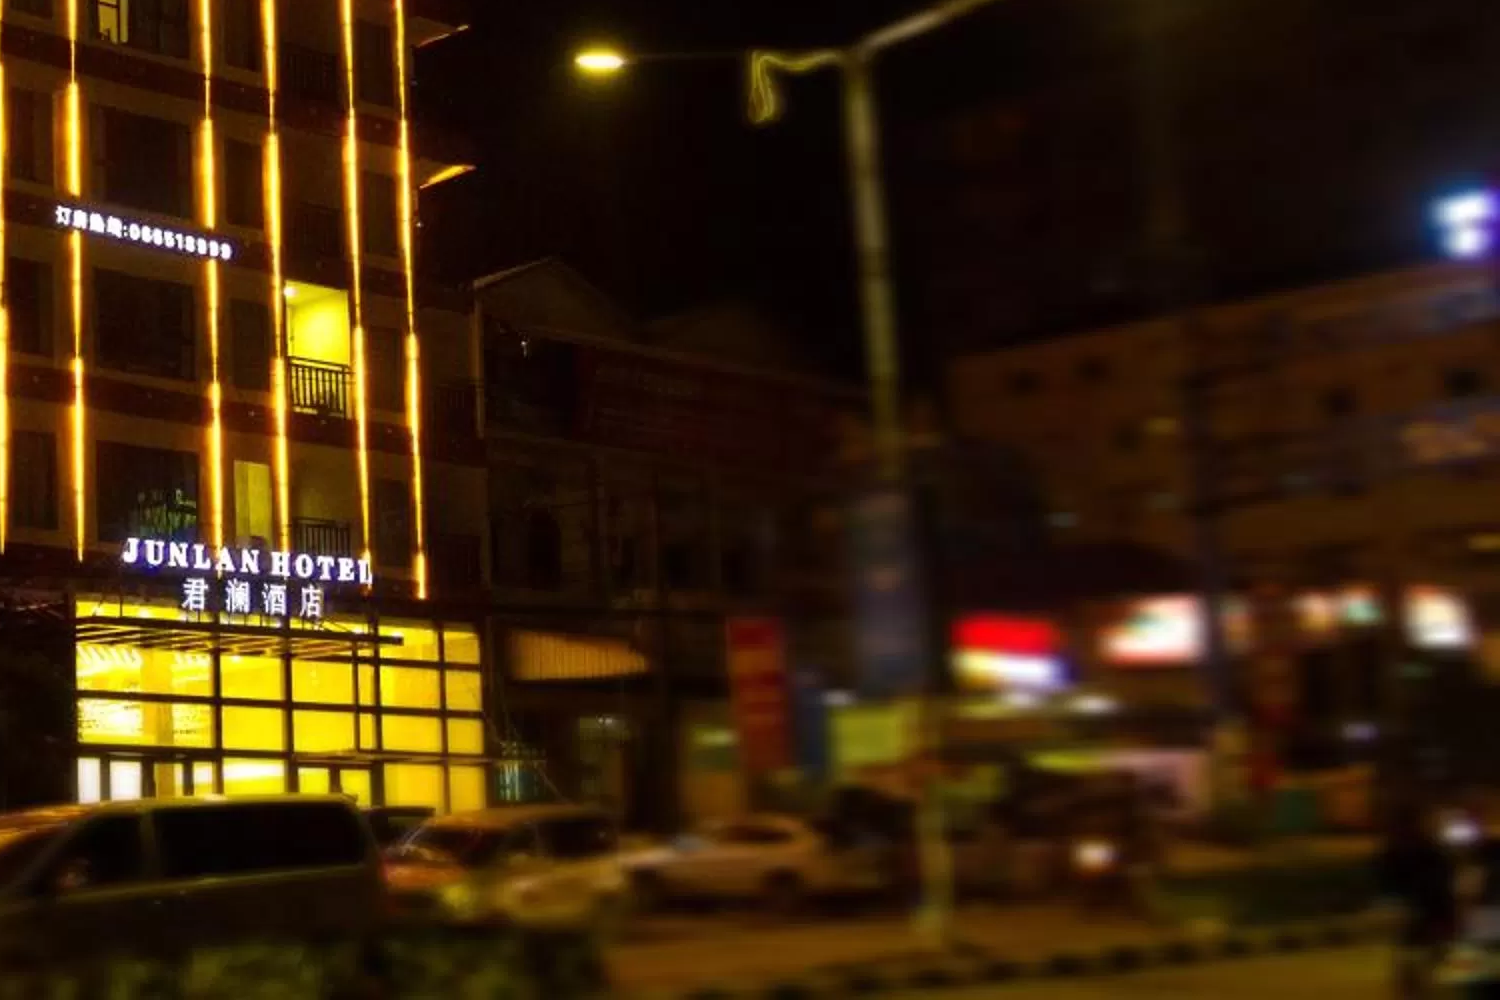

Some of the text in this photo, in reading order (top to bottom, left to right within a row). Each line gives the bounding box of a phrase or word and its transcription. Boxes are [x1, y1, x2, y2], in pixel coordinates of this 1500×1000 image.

[122, 537, 373, 584] JUNLAN HOTEL
[182, 577, 324, 618] 君澜酒店
